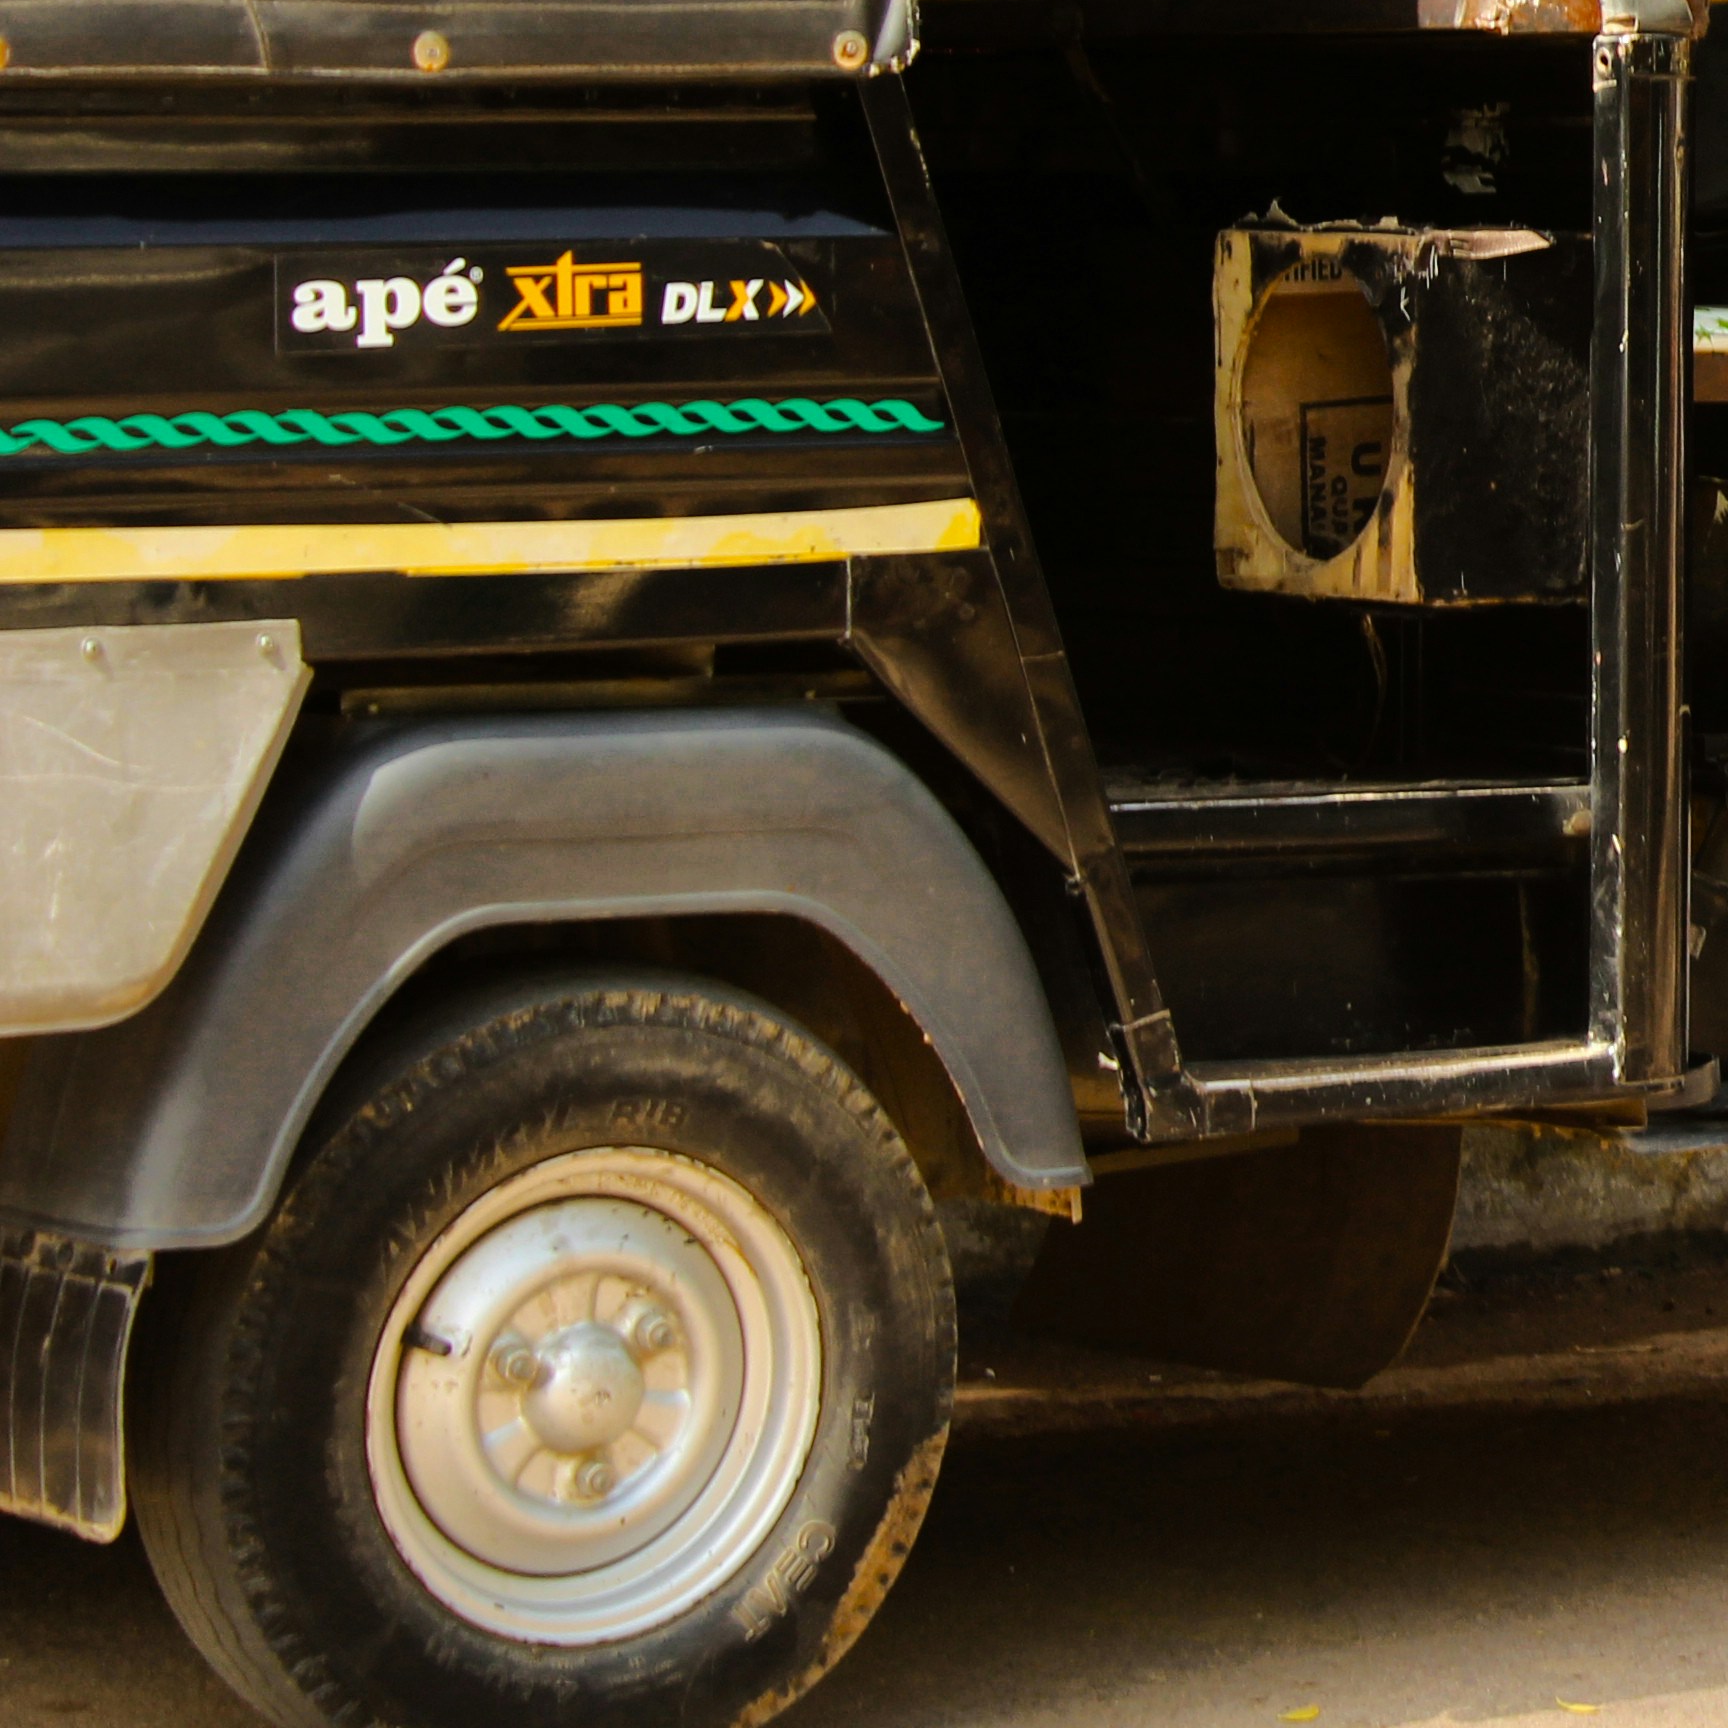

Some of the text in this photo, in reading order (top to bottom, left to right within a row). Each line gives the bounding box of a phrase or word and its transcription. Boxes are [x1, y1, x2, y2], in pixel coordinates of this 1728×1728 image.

[292, 249, 760, 349] apé xtra DLX
